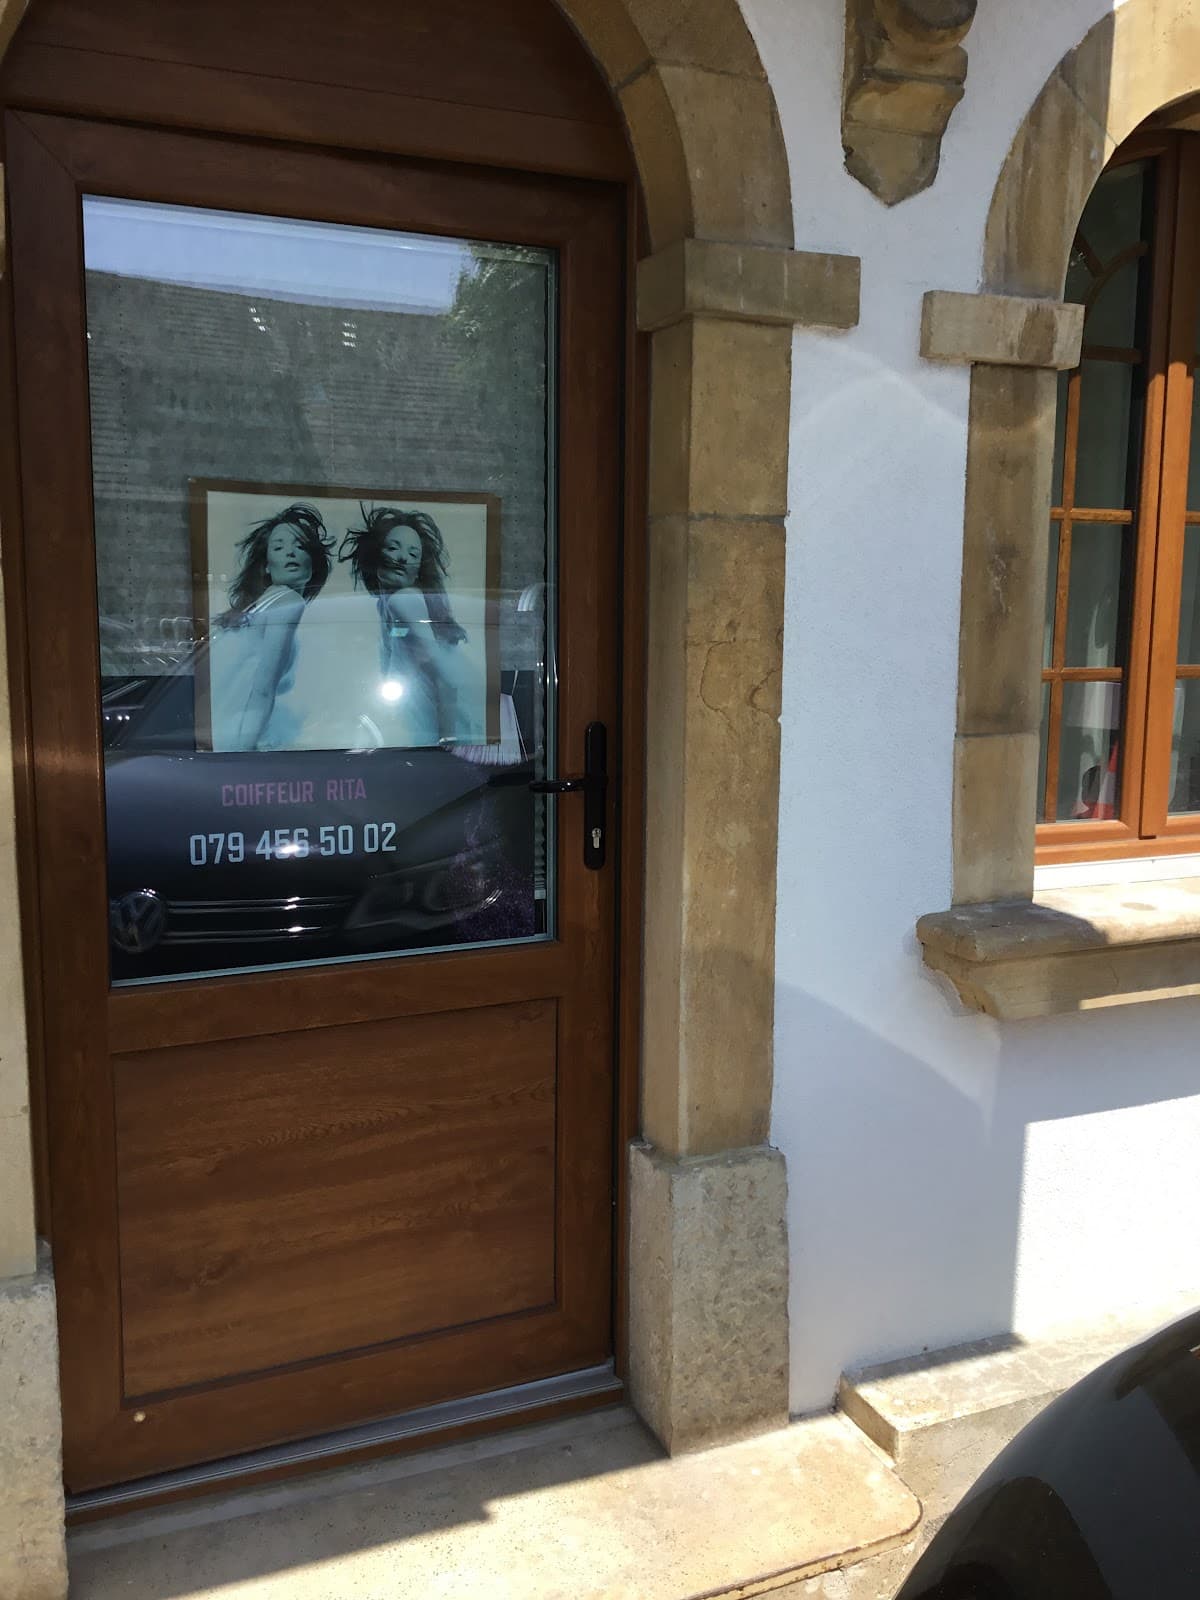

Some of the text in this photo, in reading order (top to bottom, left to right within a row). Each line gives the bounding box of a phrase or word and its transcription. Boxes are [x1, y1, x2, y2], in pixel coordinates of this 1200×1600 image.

[221, 778, 367, 807] COIFFEUR RITA
[189, 832, 244, 866] 079
[319, 824, 354, 856] 50
[363, 822, 397, 853] 02
